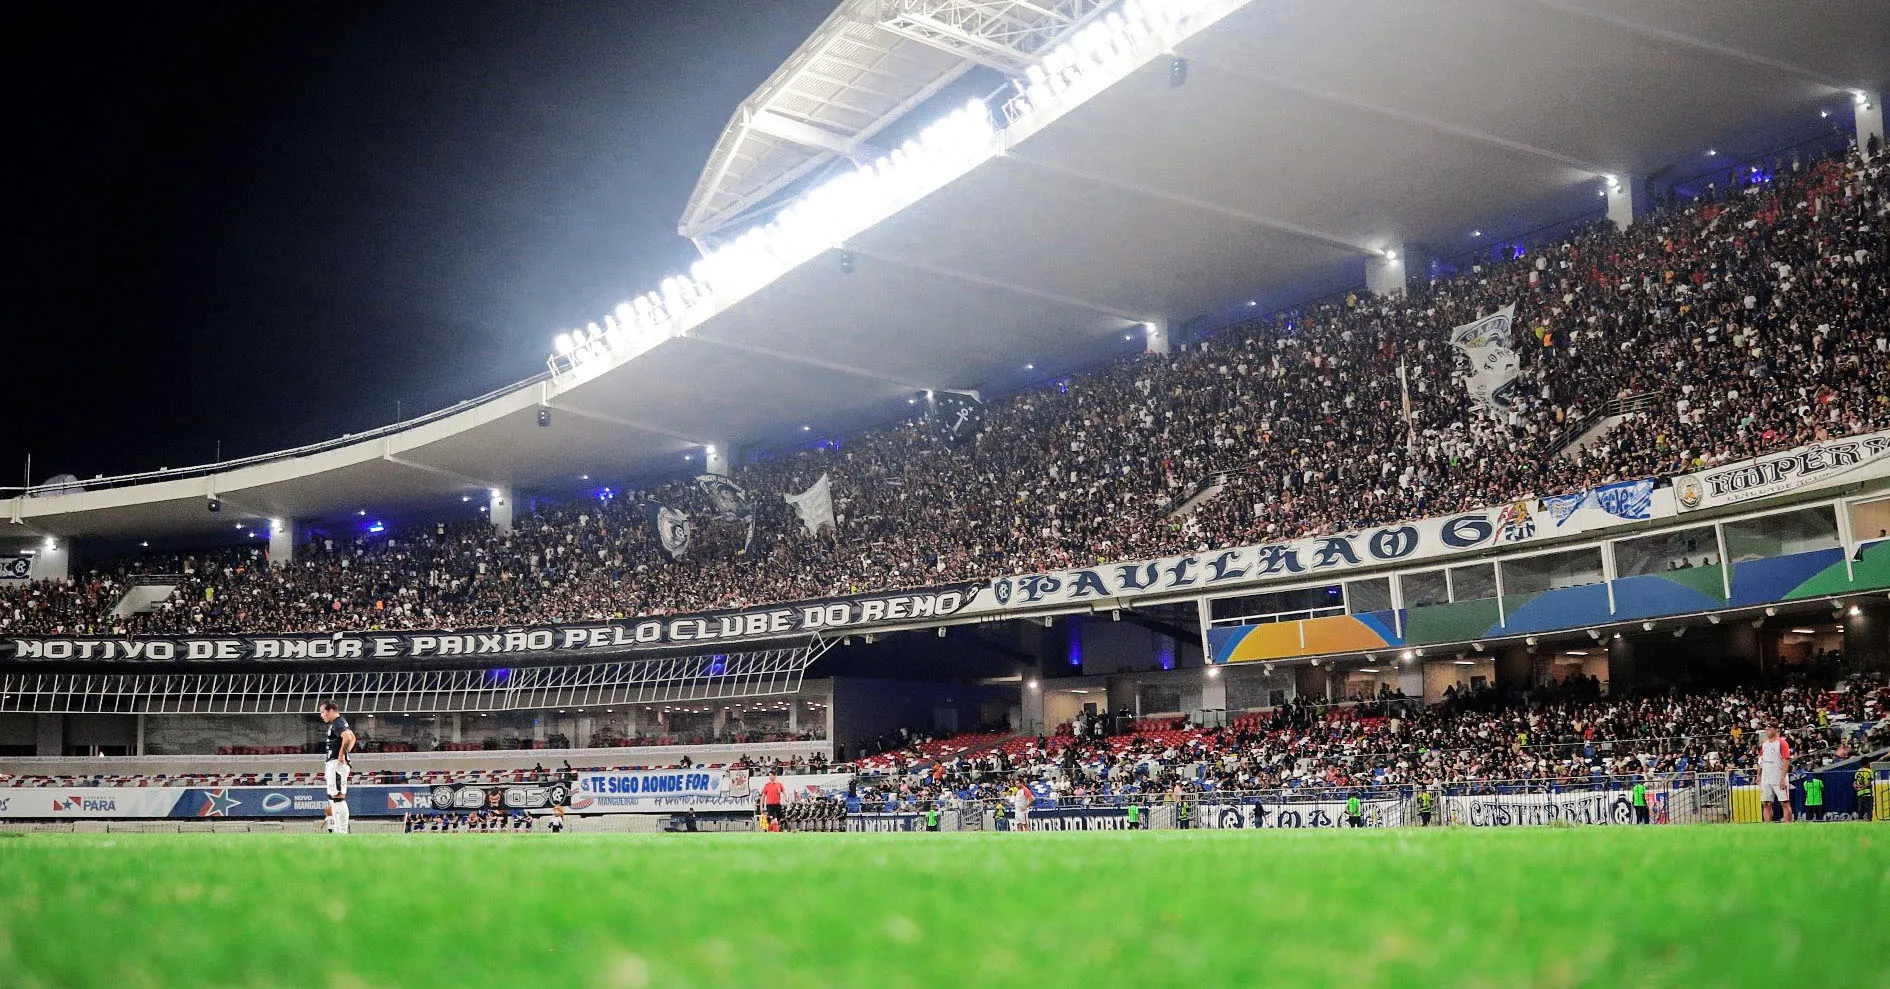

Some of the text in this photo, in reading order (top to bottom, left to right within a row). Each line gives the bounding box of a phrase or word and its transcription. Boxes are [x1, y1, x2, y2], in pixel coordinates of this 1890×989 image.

[1441, 513, 1493, 548] 6
[14, 592, 961, 660] MOTIVO DE AMOR E PAIXÃO PELO CLUBE DO REMO
[591, 773, 709, 793] TE SIGO AONDE FOR
